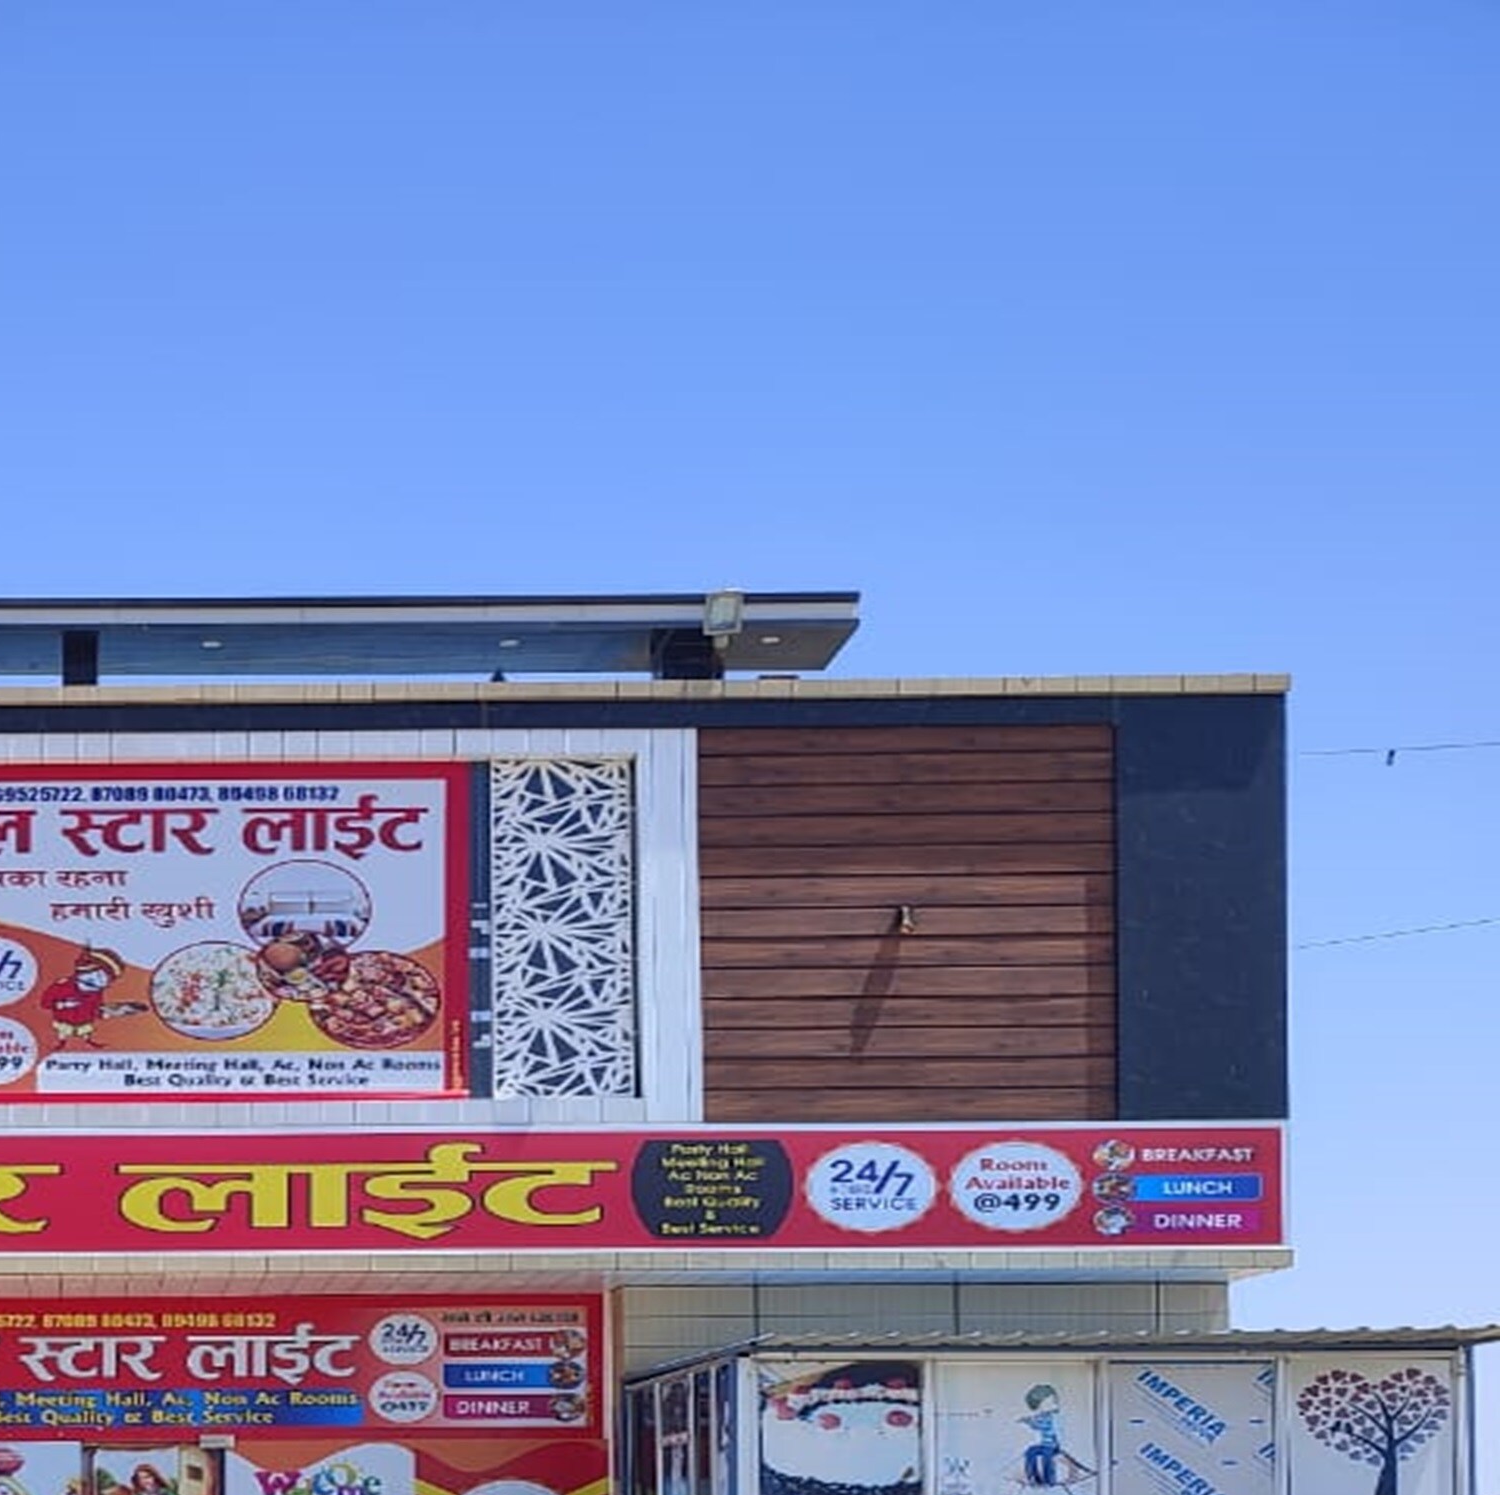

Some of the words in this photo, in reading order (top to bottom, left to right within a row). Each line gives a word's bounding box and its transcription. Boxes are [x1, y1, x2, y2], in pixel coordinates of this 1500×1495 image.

[59, 807, 220, 857] स्टार
[241, 795, 429, 860] लाईट
[56, 868, 128, 888] रहना
[50, 898, 130, 921] हमारी
[140, 897, 215, 928] खुशी
[1141, 1149, 1254, 1163] BREAKFAST
[979, 1158, 1048, 1172] Room
[829, 1159, 914, 1197] 24/7
[965, 1176, 1070, 1191] Available
[116, 1142, 618, 1240] लाईट
[1163, 1180, 1233, 1195] LUNCH
[830, 1197, 917, 1210] SERVICE
[973, 1193, 1061, 1213] @499
[1154, 1214, 1243, 1229] DINNER
[449, 1338, 543, 1351] BREAKFAST
[18, 1335, 167, 1381] स्टार
[186, 1323, 362, 1385] लाईट
[464, 1370, 525, 1382] LUNCH
[455, 1401, 530, 1414] DINNER
[1137, 1370, 1227, 1437] IMPERIA
